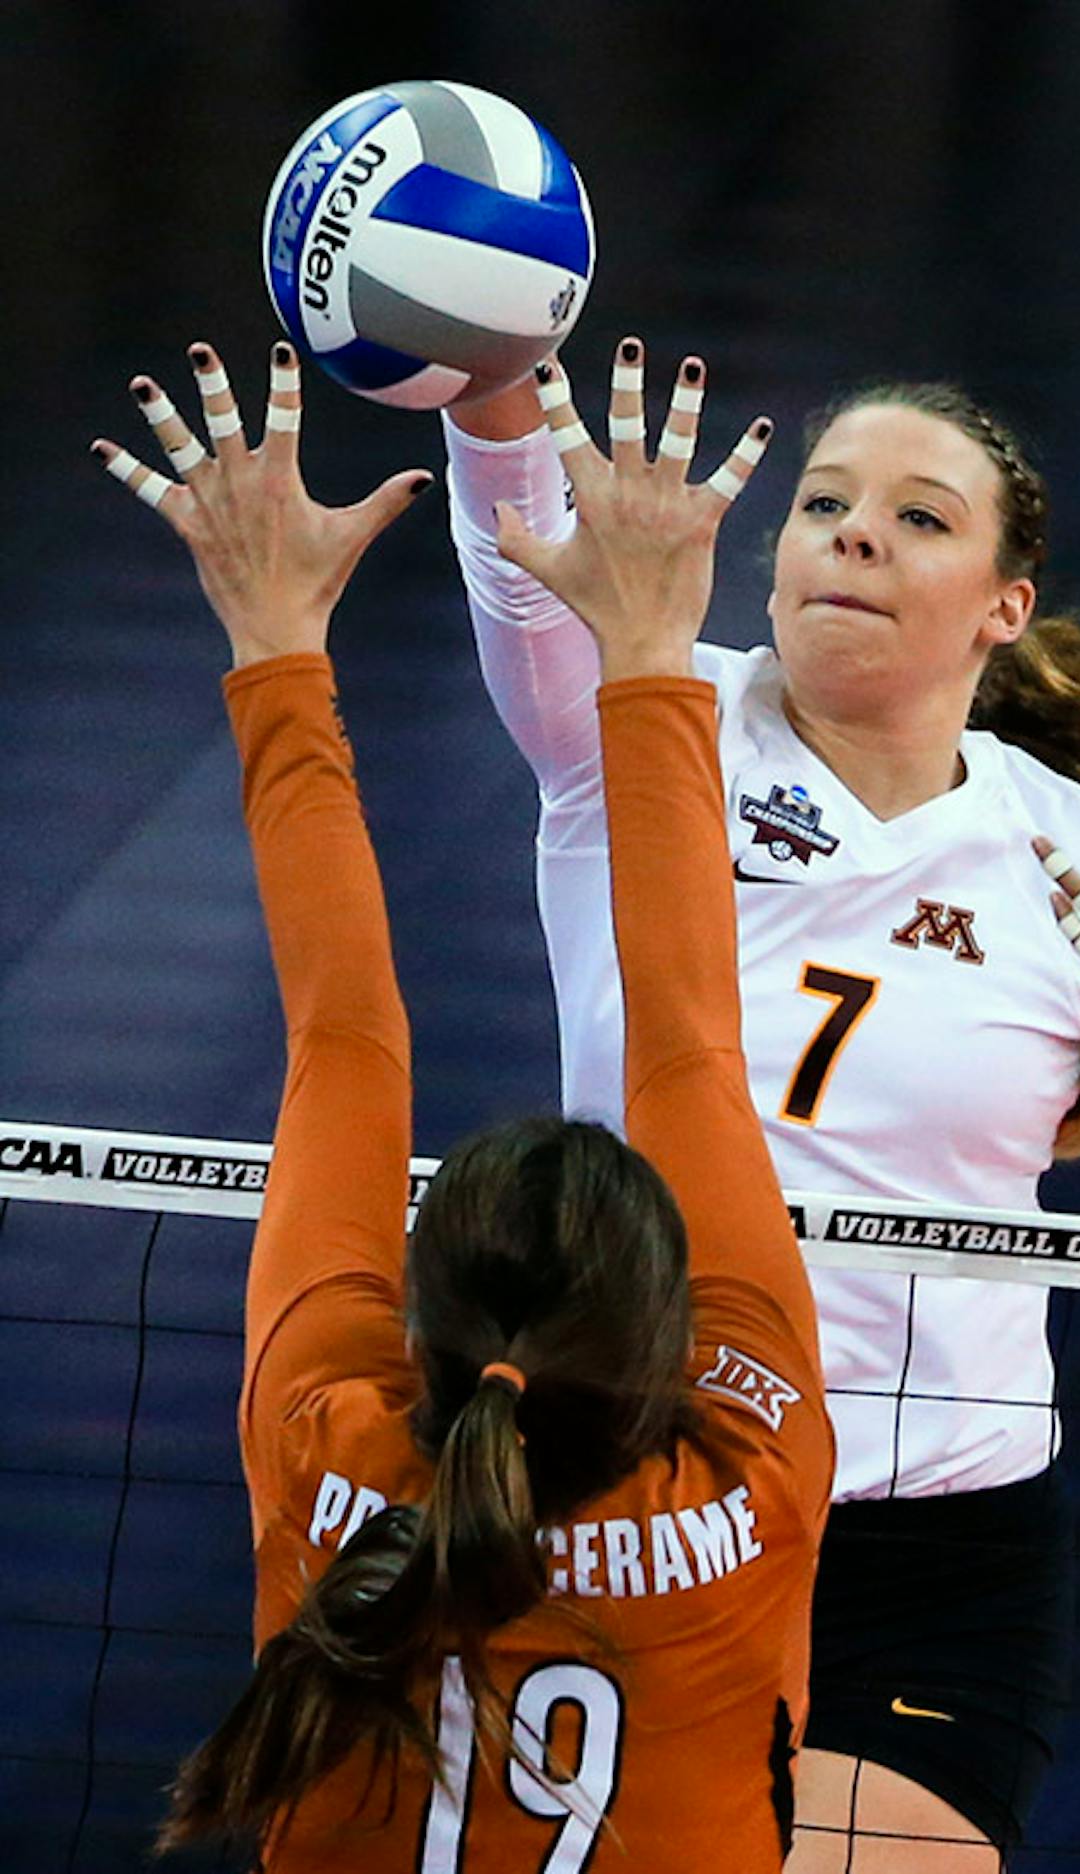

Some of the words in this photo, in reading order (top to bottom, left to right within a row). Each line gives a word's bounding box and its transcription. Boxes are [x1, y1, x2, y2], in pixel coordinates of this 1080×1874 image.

[304, 143, 387, 311] molten
[777, 960, 881, 1127] 7
[0, 1138, 83, 1178] CAA
[112, 1152, 268, 1189] VOLLEYB
[836, 1214, 1056, 1256] VOLLEYBALL
